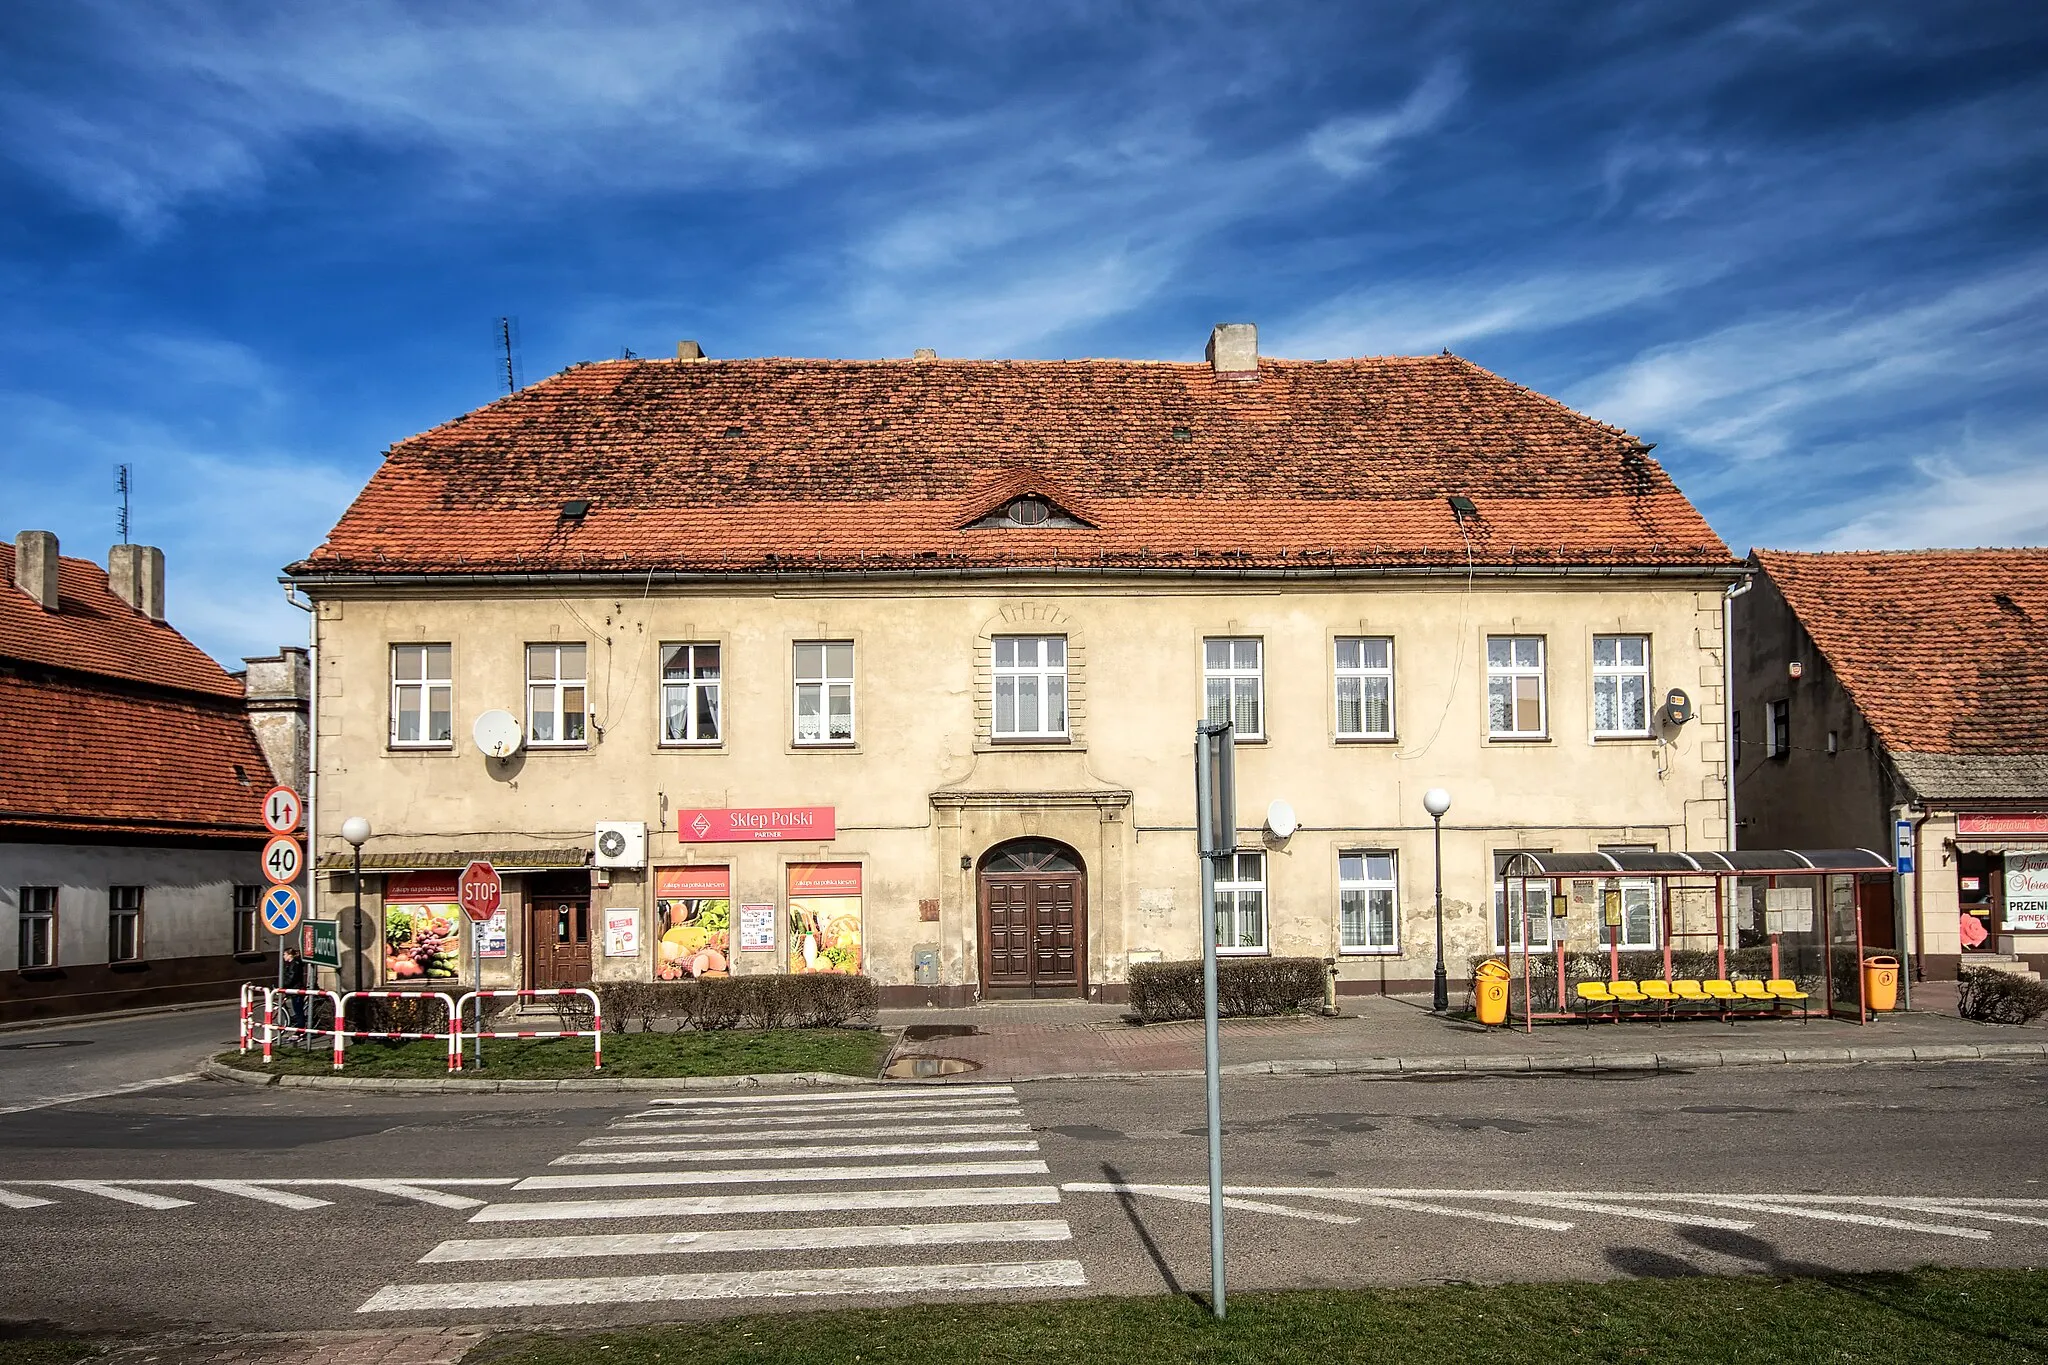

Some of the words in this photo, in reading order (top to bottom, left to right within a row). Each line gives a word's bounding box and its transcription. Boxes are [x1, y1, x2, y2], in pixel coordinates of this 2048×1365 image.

[730, 812, 768, 828] Sklep
[772, 811, 813, 827] Polski
[269, 849, 295, 871] 40
[465, 882, 498, 901] STOP
[2018, 914, 2045, 922] RYNEK
[315, 929, 336, 957] Jarocin
